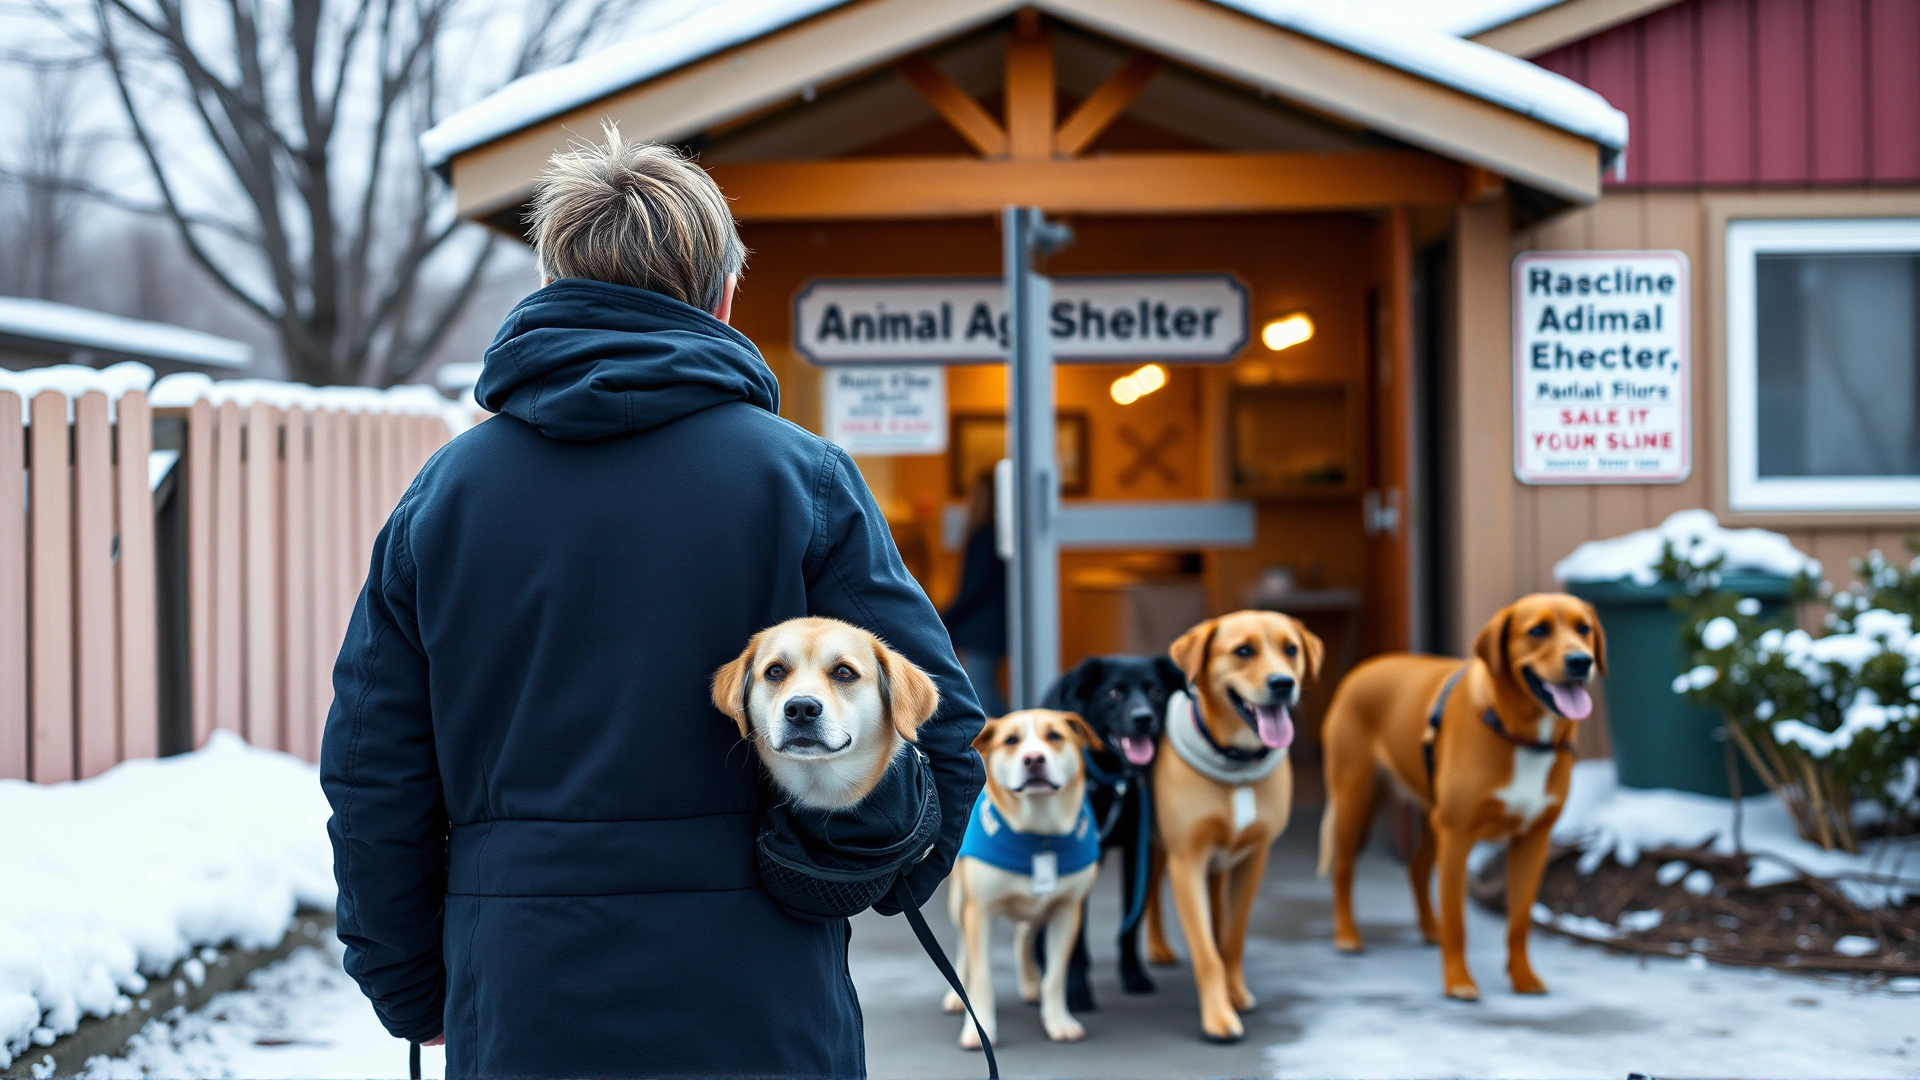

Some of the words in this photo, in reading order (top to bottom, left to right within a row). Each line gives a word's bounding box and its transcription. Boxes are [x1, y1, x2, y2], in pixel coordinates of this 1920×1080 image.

[816, 302, 952, 343] Animal
[1049, 299, 1221, 341] Shelter
[1539, 304, 1663, 332] Adimal
[1561, 410, 1618, 425] SALE
[1629, 410, 1650, 425] IT
